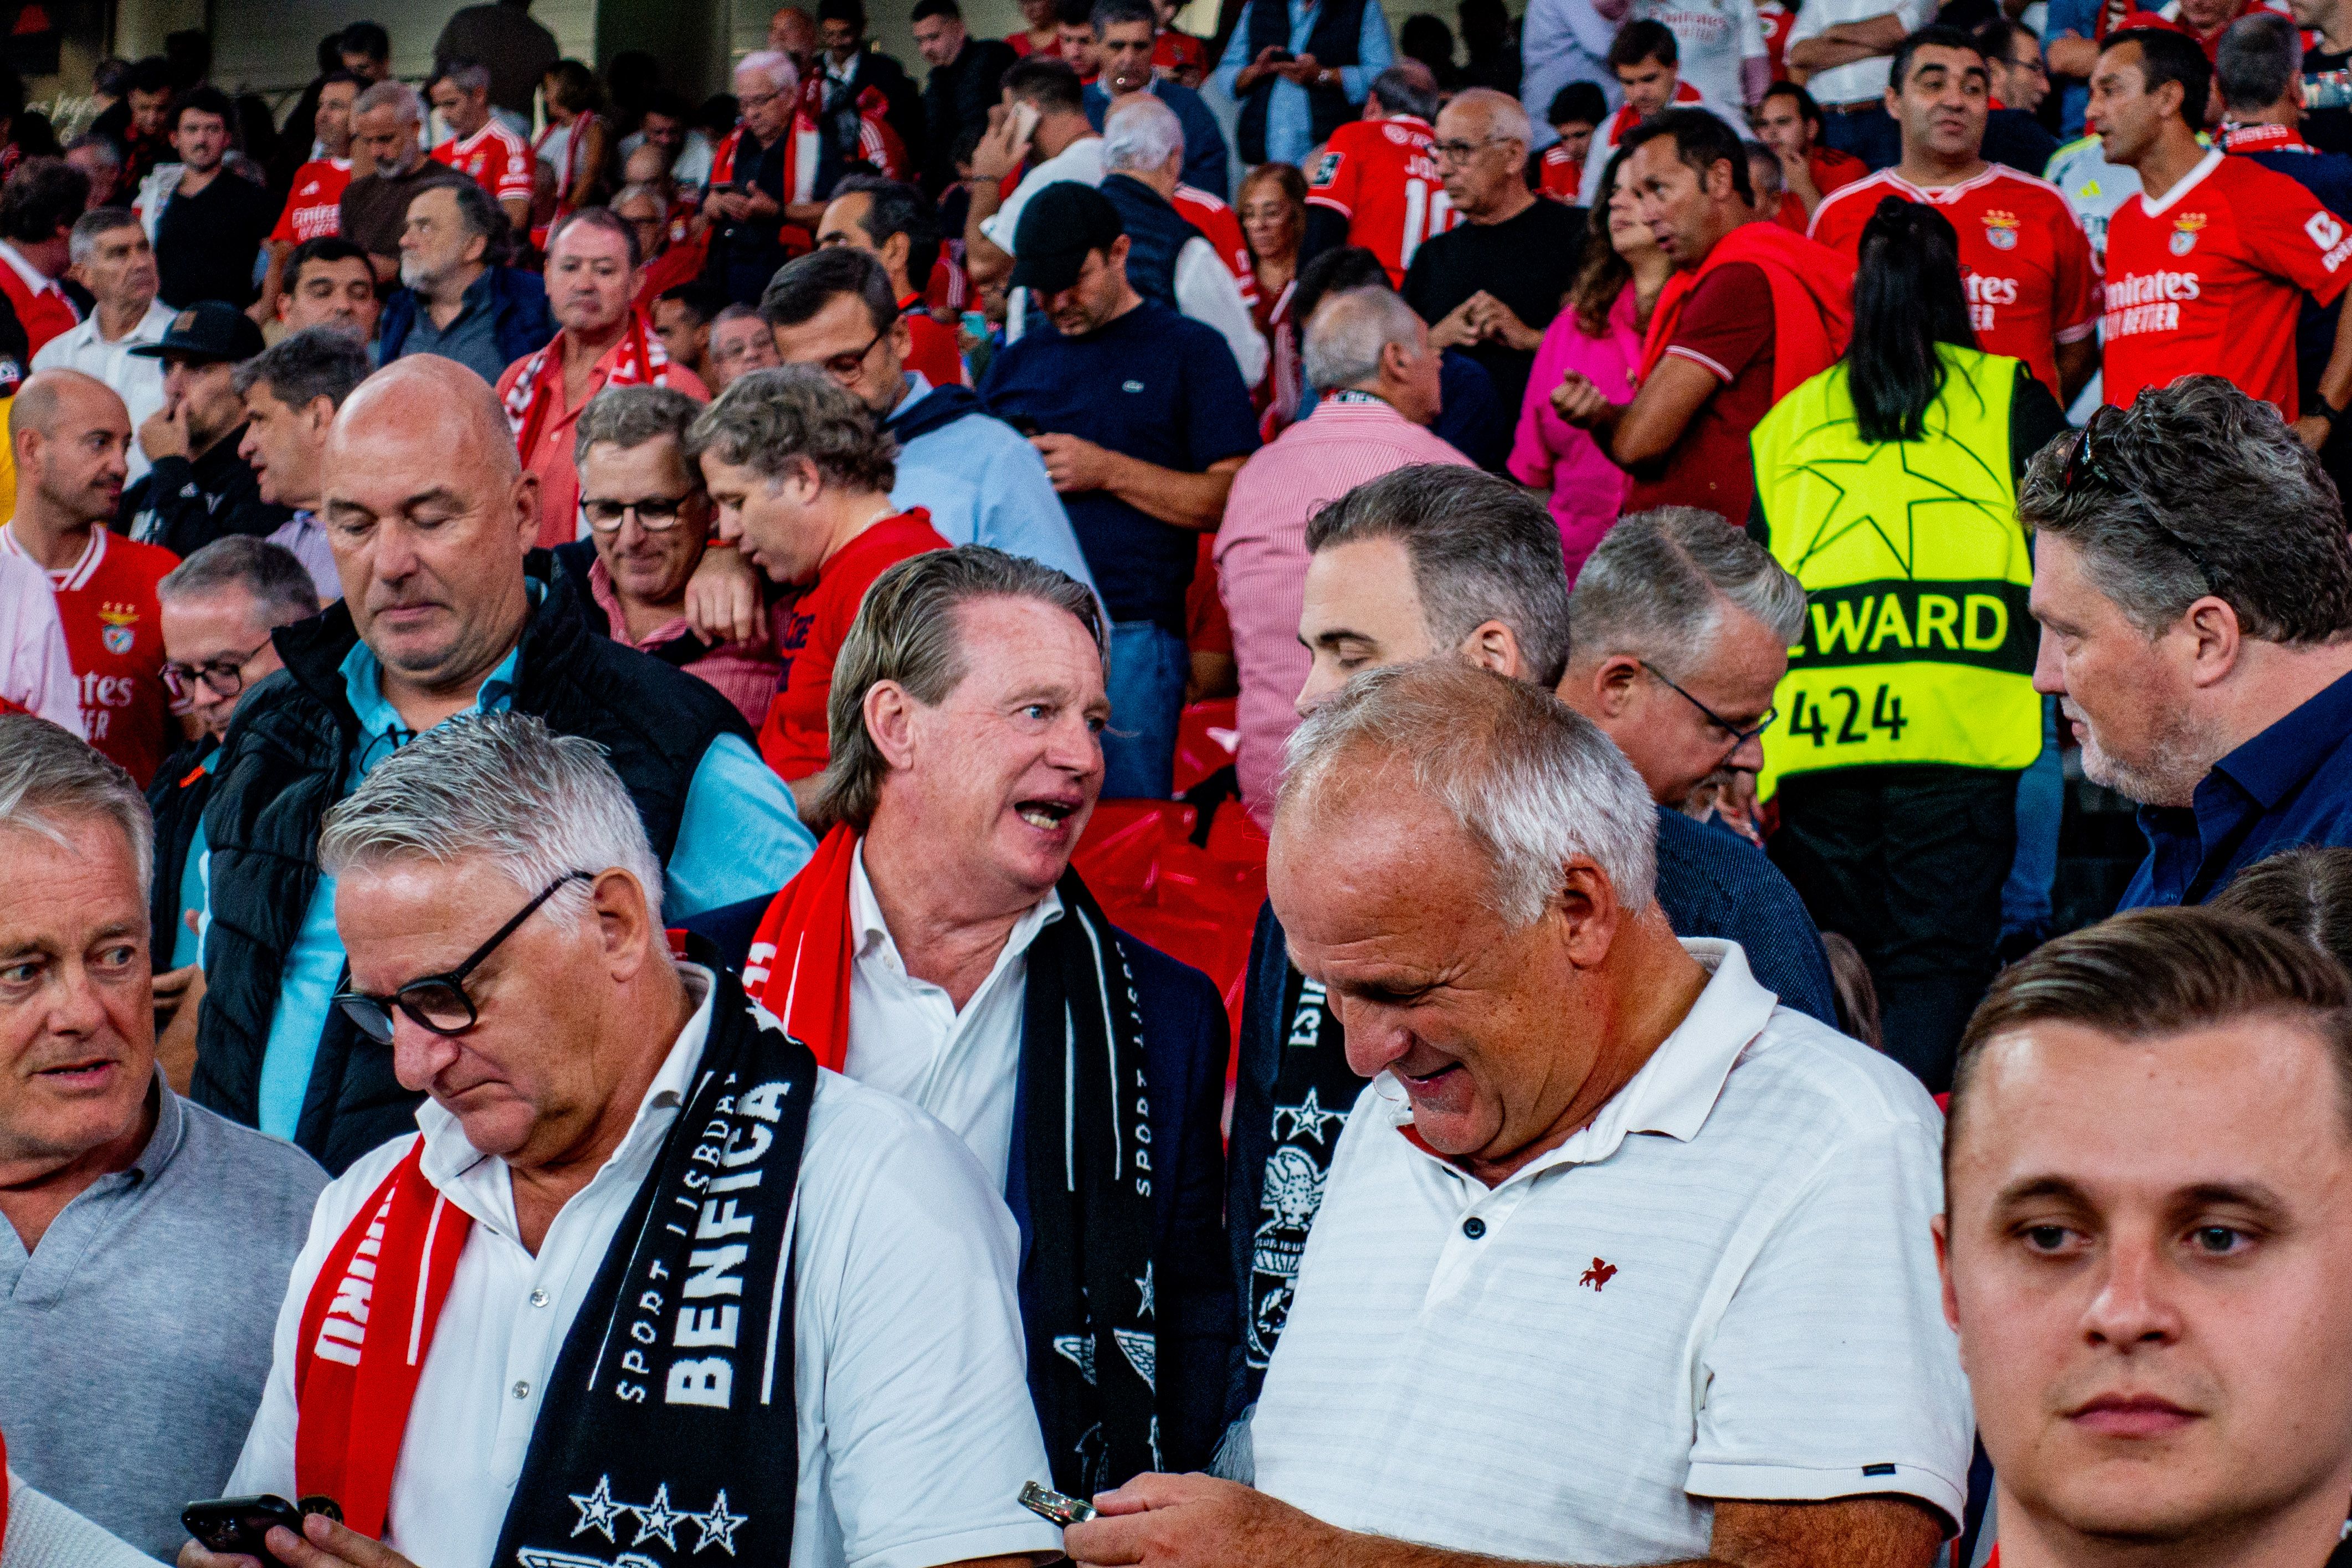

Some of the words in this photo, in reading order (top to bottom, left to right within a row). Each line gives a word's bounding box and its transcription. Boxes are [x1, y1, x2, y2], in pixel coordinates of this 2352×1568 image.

[2105, 269, 2200, 310] mirates
[1788, 592, 2009, 659] WARD
[1789, 683, 1909, 748] 424
[664, 1080, 792, 1409] BENFICA
[615, 1258, 670, 1405] SPORT
